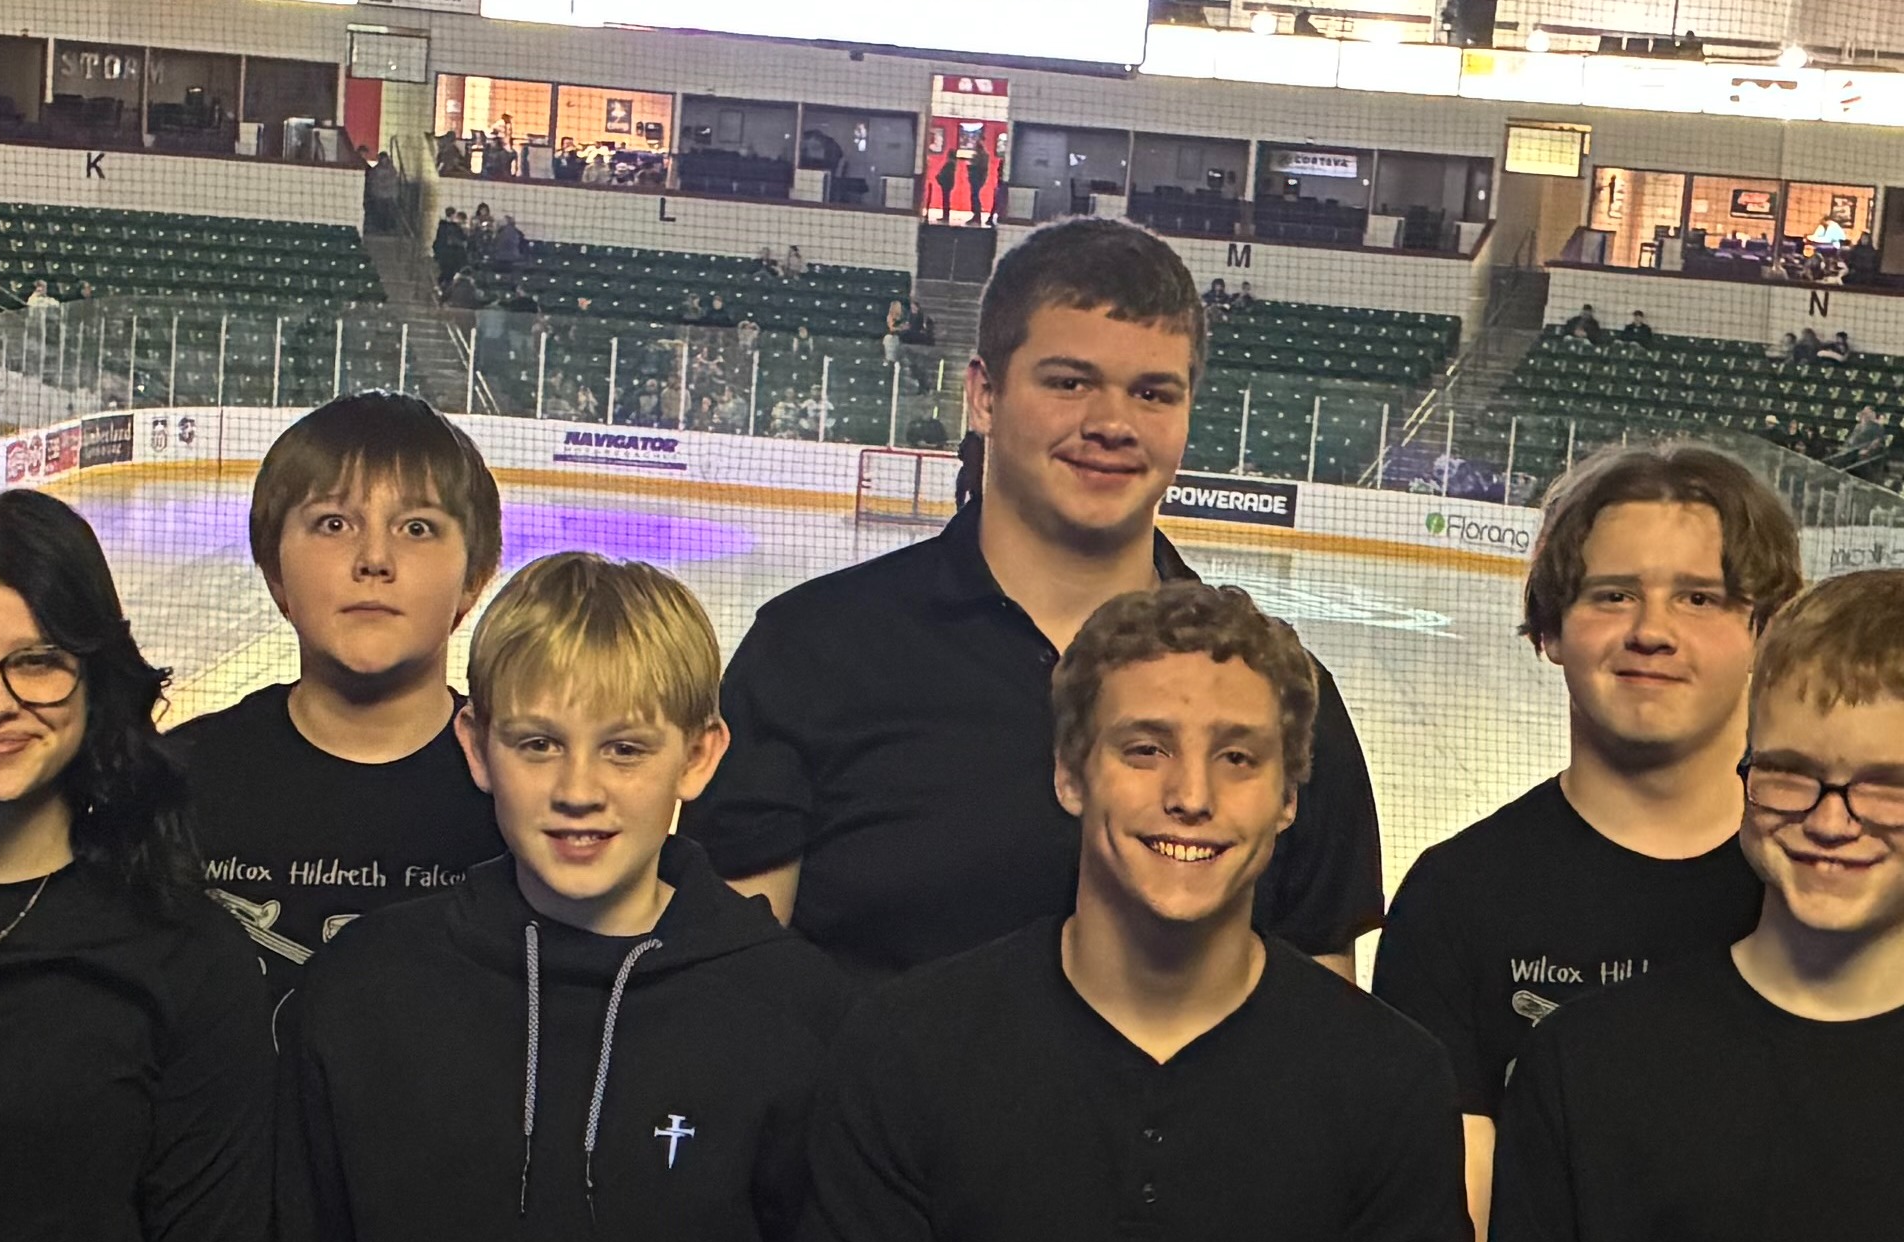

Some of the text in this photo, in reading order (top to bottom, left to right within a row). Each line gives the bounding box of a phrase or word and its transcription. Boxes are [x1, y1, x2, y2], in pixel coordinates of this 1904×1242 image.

[87, 152, 105, 179] K
[659, 197, 676, 222] L
[1227, 243, 1251, 268] M
[1809, 290, 1829, 318] N
[564, 431, 679, 453] NAVIGATOR
[1166, 486, 1288, 515] POWERADE
[289, 858, 386, 888] Hildreth
[1511, 955, 1584, 983] Wilcox
